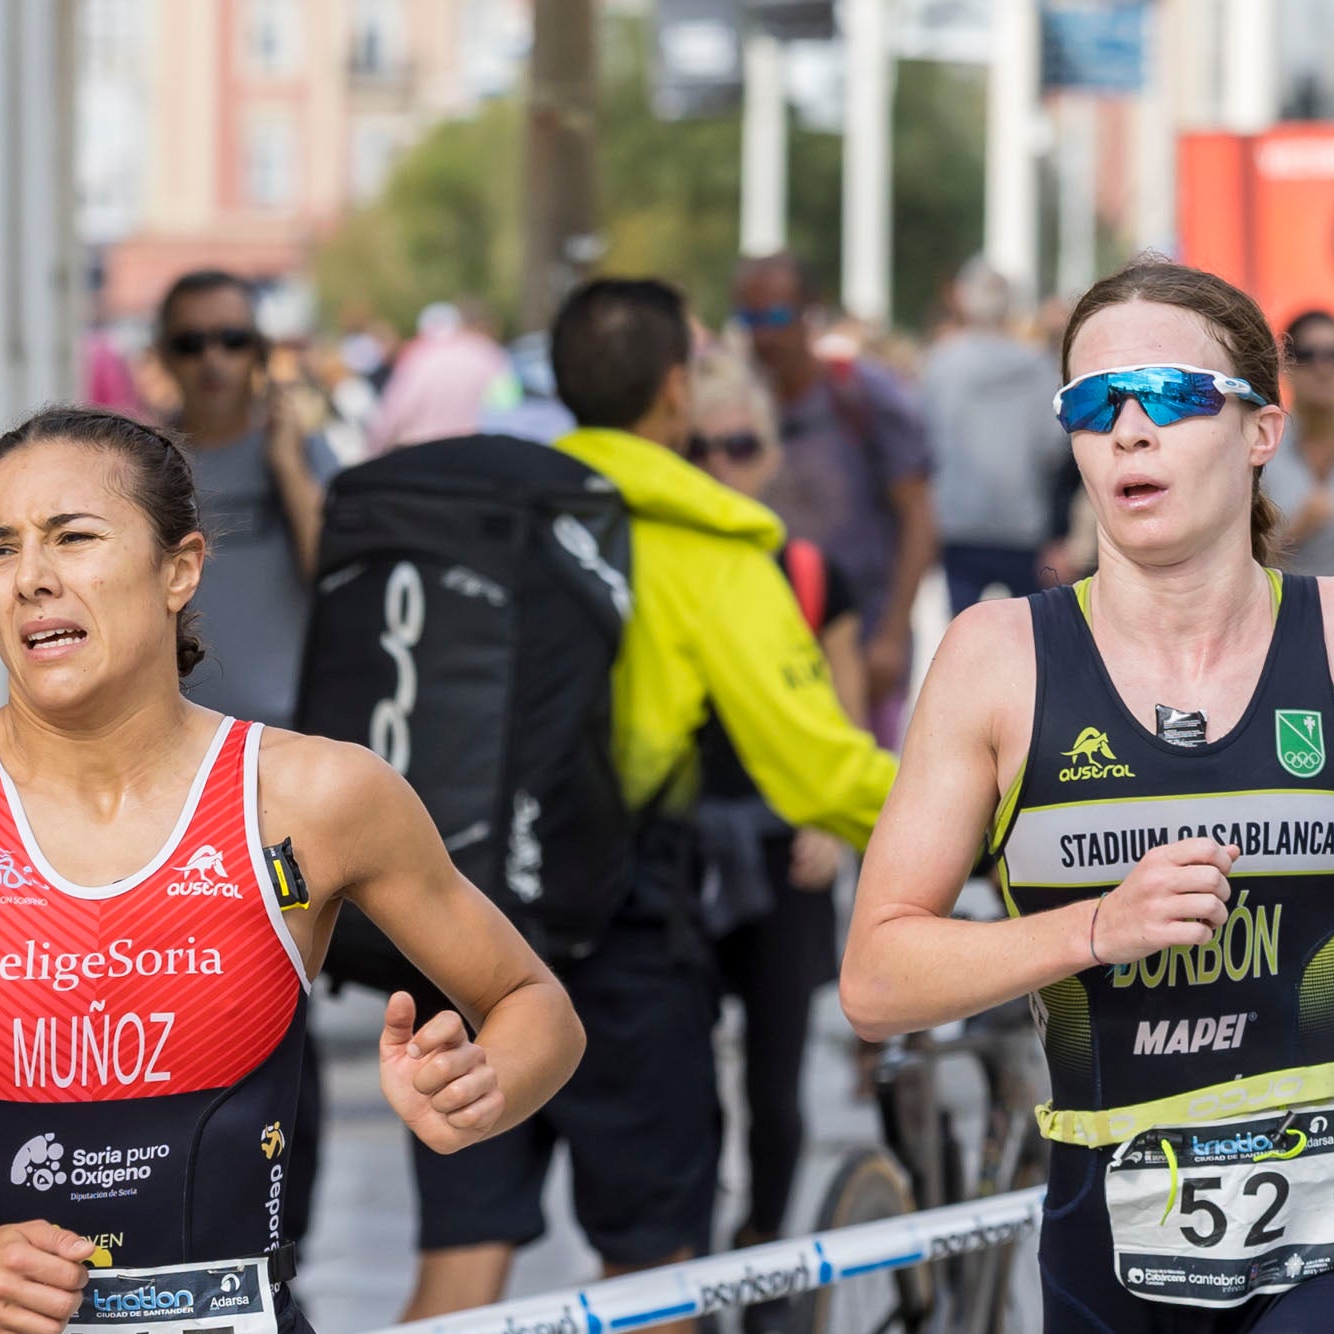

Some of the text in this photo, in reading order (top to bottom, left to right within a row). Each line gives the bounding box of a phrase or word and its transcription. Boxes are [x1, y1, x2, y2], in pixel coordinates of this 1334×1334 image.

[1058, 764, 1136, 782] austral
[167, 881, 243, 899] austral
[12, 1000, 176, 1088] MUÑOZ
[1192, 1132, 1273, 1155] triatlo
[1305, 1135, 1334, 1149] darsa
[72, 1144, 170, 1166] Soria puro
[1194, 1154, 1226, 1163] CIUDAD
[70, 1166, 152, 1188] Oxígeno
[108, 1189, 118, 1198] de
[1179, 1172, 1290, 1248] 52
[1188, 1273, 1246, 1286] cantabria
[93, 1286, 194, 1312] triatlon
[210, 1295, 250, 1309] Adarsa
[143, 1307, 195, 1317] SANTANDER
